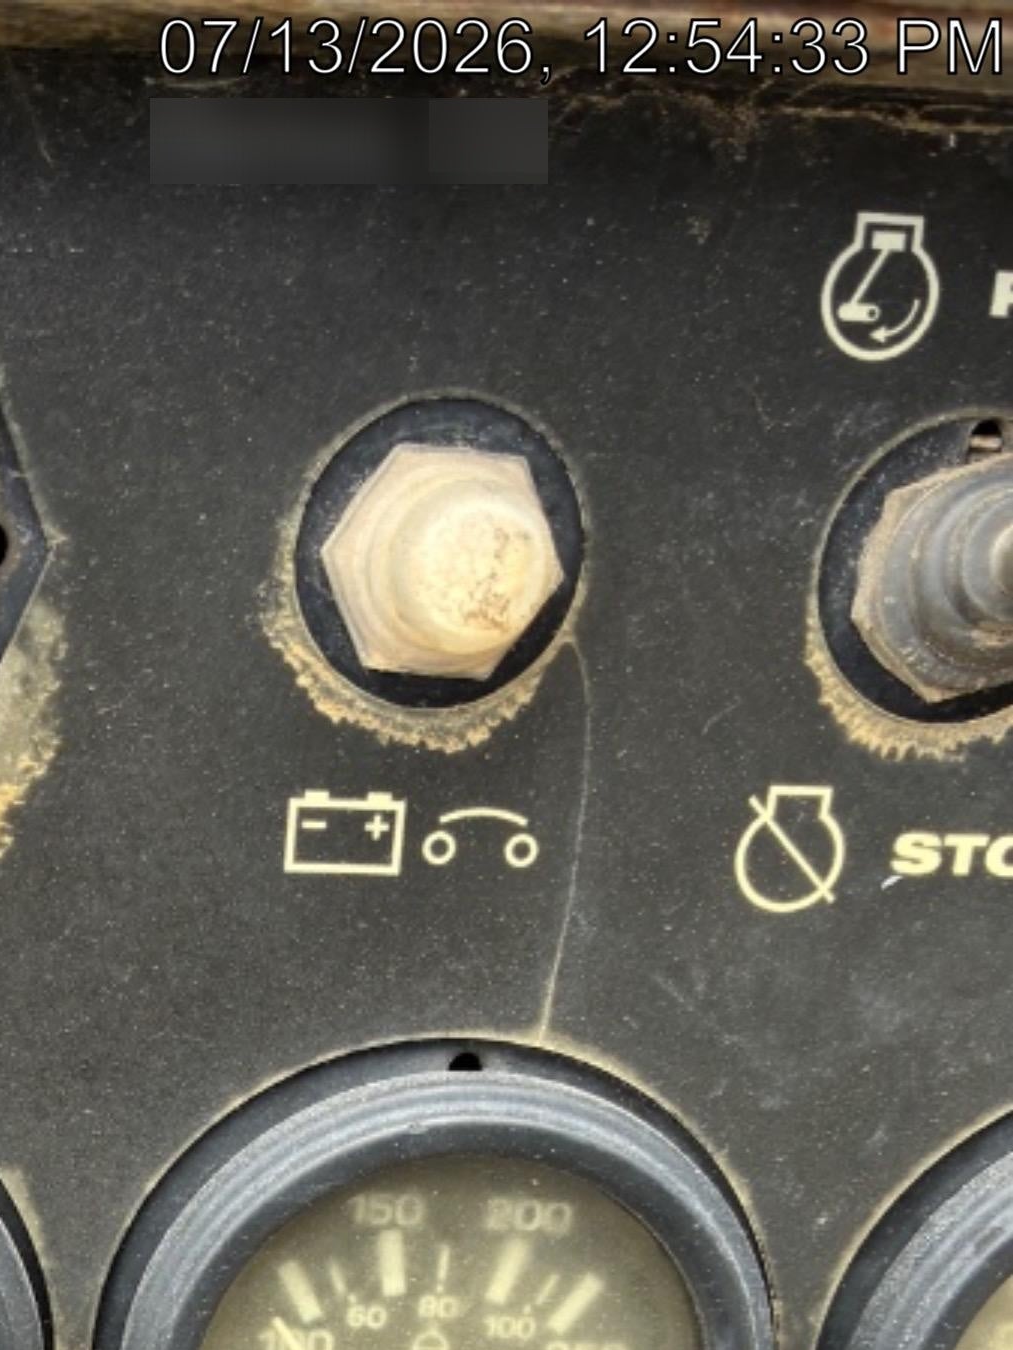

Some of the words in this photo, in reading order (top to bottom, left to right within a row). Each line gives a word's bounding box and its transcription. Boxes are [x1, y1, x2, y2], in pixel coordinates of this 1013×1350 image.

[350, 1196, 424, 1226] 150
[486, 1200, 572, 1232] 200
[485, 1314, 537, 1340] 100
